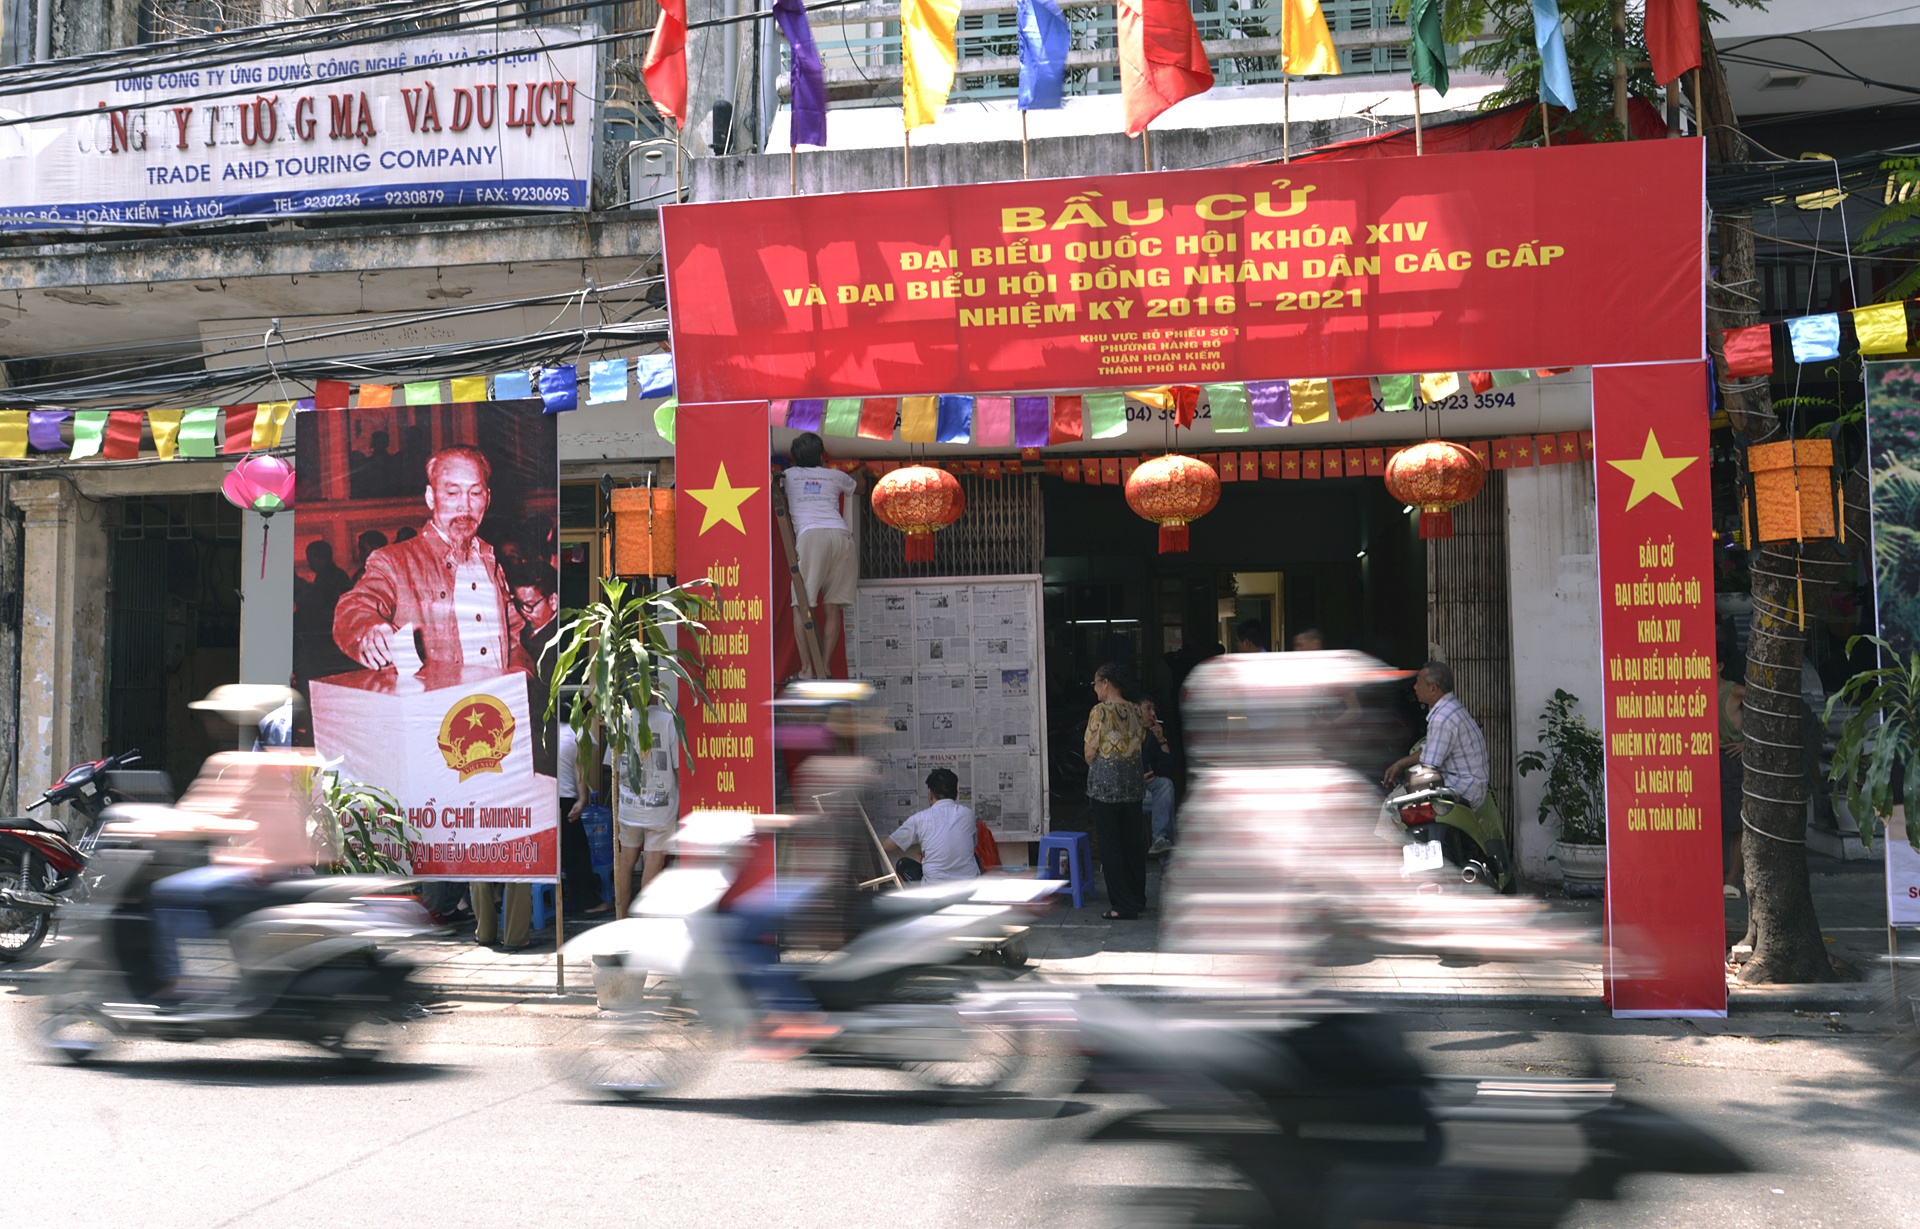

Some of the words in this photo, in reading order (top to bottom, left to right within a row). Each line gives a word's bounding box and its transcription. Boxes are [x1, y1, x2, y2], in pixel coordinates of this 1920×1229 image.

[206, 70, 225, 86] TY
[230, 65, 262, 85] ỨNG
[317, 57, 360, 78] CÔNG
[400, 80, 442, 134] VÀ
[449, 84, 497, 132] DU
[505, 80, 577, 138] LỊCH
[146, 163, 211, 185] TRADE
[222, 160, 269, 182] AND
[275, 153, 371, 177] TOURING
[379, 145, 498, 170] COMPANY
[76, 204, 120, 222] HOÀN
[125, 201, 160, 220] KIẾM
[172, 201, 193, 219] HÀ
[197, 200, 223, 219] NỘI
[303, 193, 361, 209] 9230236
[384, 189, 445, 206] 9230879
[476, 187, 508, 202] FAX:
[511, 186, 570, 201] 9230695
[1001, 190, 1164, 233] BẦU
[1195, 178, 1317, 221] CỬ
[900, 249, 958, 273] ĐẠI
[971, 237, 1052, 267] BIỂU
[1065, 231, 1162, 263] QUỐC
[1175, 230, 1237, 258] HỘI
[1250, 224, 1353, 251] KHÓA
[1365, 221, 1428, 244] XIV
[783, 284, 827, 307] VÀ
[837, 283, 894, 306] ĐẠI
[906, 271, 986, 300] BIỂU
[998, 270, 1057, 298] HỘI
[1069, 263, 1170, 292] ĐỒNG
[1183, 258, 1288, 285] NHÂN
[1302, 253, 1380, 279] DÂN
[1394, 247, 1472, 274] CÁC
[1486, 239, 1565, 269] CẤP
[959, 301, 1075, 328] NHIỆM
[1088, 297, 1134, 321] KỲ
[1147, 295, 1236, 318] 2016
[1275, 288, 1362, 312] 2021
[1080, 334, 1108, 343] KHU
[1111, 332, 1138, 342] VỰC
[1142, 328, 1161, 340] BỎ
[1164, 327, 1206, 339] PHIẾU
[1209, 325, 1229, 337] SỐ
[1100, 342, 1157, 353] PHƯỜNG
[1160, 340, 1198, 351] HÀNG
[1098, 365, 1143, 375] THÀNH
[1147, 361, 1174, 373] PHỐ
[1178, 361, 1197, 372] HÀ
[1201, 361, 1225, 372] NỘI
[1101, 353, 1139, 364] QUẬN
[1143, 352, 1181, 362] HOÀN
[1185, 348, 1220, 360] KIẾM
[1125, 406, 1151, 421] 04)
[1428, 394, 1469, 410] 3923
[1474, 392, 1516, 409] 3594
[1639, 536, 1659, 568] BẦU
[1660, 534, 1675, 568] CỬ
[707, 559, 725, 587] BẦU
[727, 557, 740, 587] CỬ
[723, 592, 746, 623] QUỐC
[748, 595, 763, 625] HỘI
[1615, 583, 1631, 611] ĐẠI
[1633, 573, 1655, 606] BIỂU
[1657, 573, 1683, 608] QUỐC
[1684, 576, 1701, 609] HỘI
[712, 634, 727, 660] ĐẠI
[729, 626, 749, 655] BIỂU
[1637, 615, 1664, 643] KHÓA
[1665, 619, 1681, 642] XIV
[706, 664, 720, 694] HỘI
[722, 661, 746, 689] ĐỒNG
[1610, 653, 1623, 681] VÀ
[1625, 657, 1641, 686] ĐẠI
[1643, 648, 1665, 681] BIỂU
[1666, 652, 1683, 685] HỘI
[1684, 649, 1711, 680] ĐỒNG
[729, 698, 747, 723] DÂN
[1616, 690, 1643, 718] NHÂN
[1645, 690, 1665, 718] DÂN
[1666, 690, 1686, 718] CÁC
[1688, 686, 1707, 718] CẤP
[697, 732, 708, 758] LÀ
[709, 729, 738, 760] QUYỀN
[740, 735, 754, 763] LỢI
[1611, 728, 1643, 761] NHIỆM
[1645, 728, 1657, 756] KỲ
[1659, 732, 1683, 756] 2016
[1690, 732, 1713, 755] 2021
[717, 762, 735, 792] CỦA
[1634, 765, 1648, 794] LÀ
[1649, 765, 1675, 793] NGÀY
[1676, 765, 1693, 798] HỘI
[408, 797, 436, 829] HỒ
[441, 801, 475, 829] CHÍ
[479, 806, 532, 829] MINH
[1627, 798, 1648, 831] CỦA
[1648, 803, 1674, 831] TOÀN
[1676, 803, 1696, 831] DÂN
[432, 830, 466, 863] BIỂU
[467, 833, 511, 863] QUỐC
[512, 836, 539, 869] HỘI
